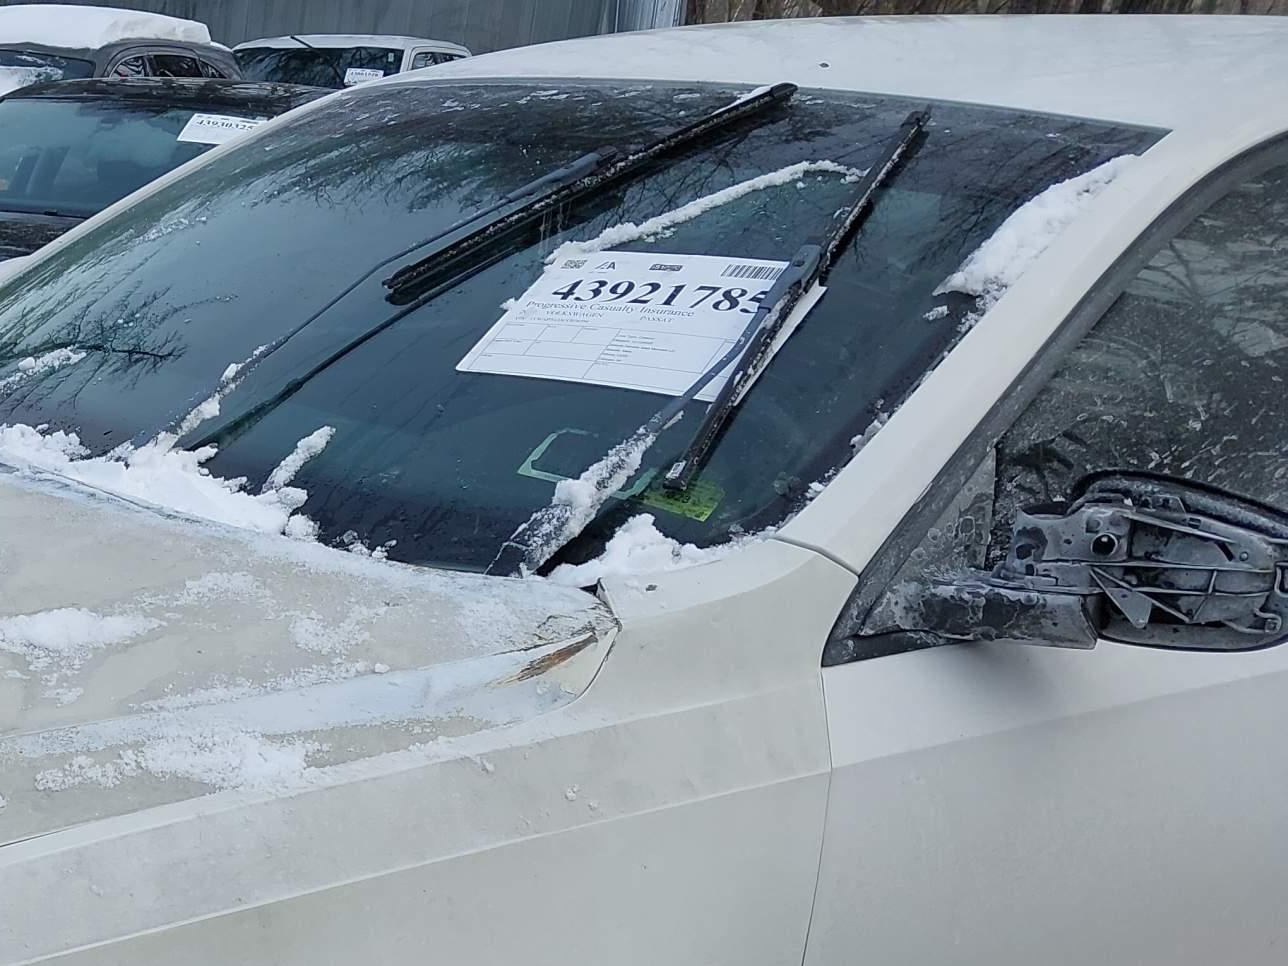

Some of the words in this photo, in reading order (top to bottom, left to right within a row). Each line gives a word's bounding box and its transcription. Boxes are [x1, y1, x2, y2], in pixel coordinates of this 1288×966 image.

[526, 301, 588, 310] Progressive
[589, 302, 635, 314] Casualty
[639, 306, 695, 317] Insurance
[551, 279, 770, 314] 43921785
